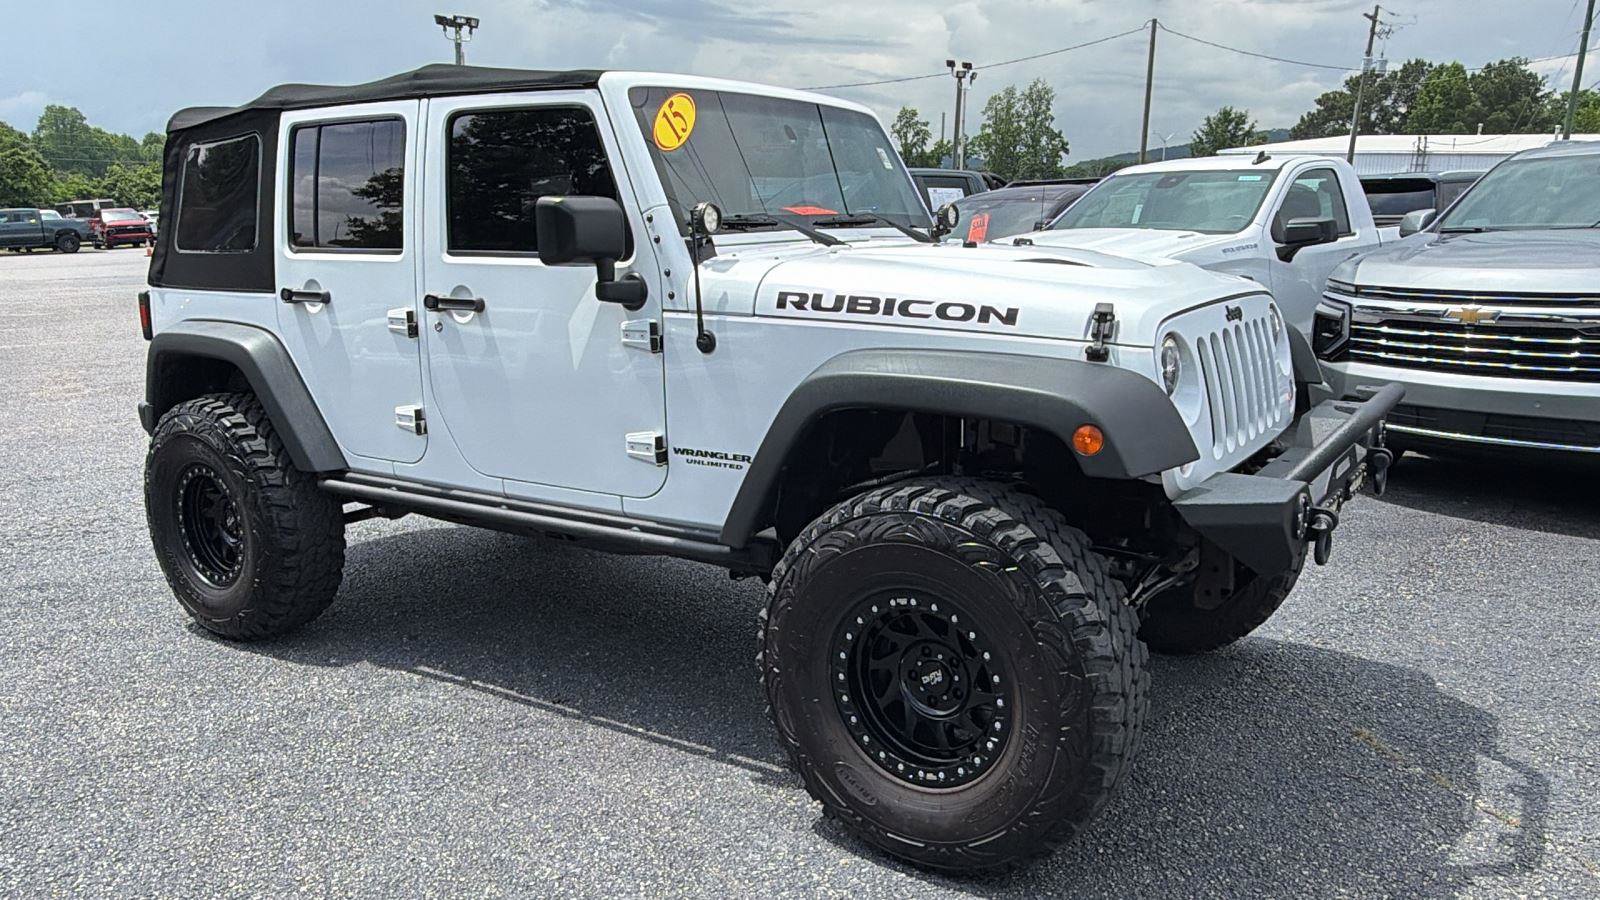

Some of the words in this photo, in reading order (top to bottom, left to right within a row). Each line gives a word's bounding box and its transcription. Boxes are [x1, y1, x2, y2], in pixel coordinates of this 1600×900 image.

[662, 100, 688, 143] 15
[775, 291, 1019, 326] RUBICON
[673, 447, 752, 464] WRANGLER
[686, 458, 744, 470] UNLIMITED
